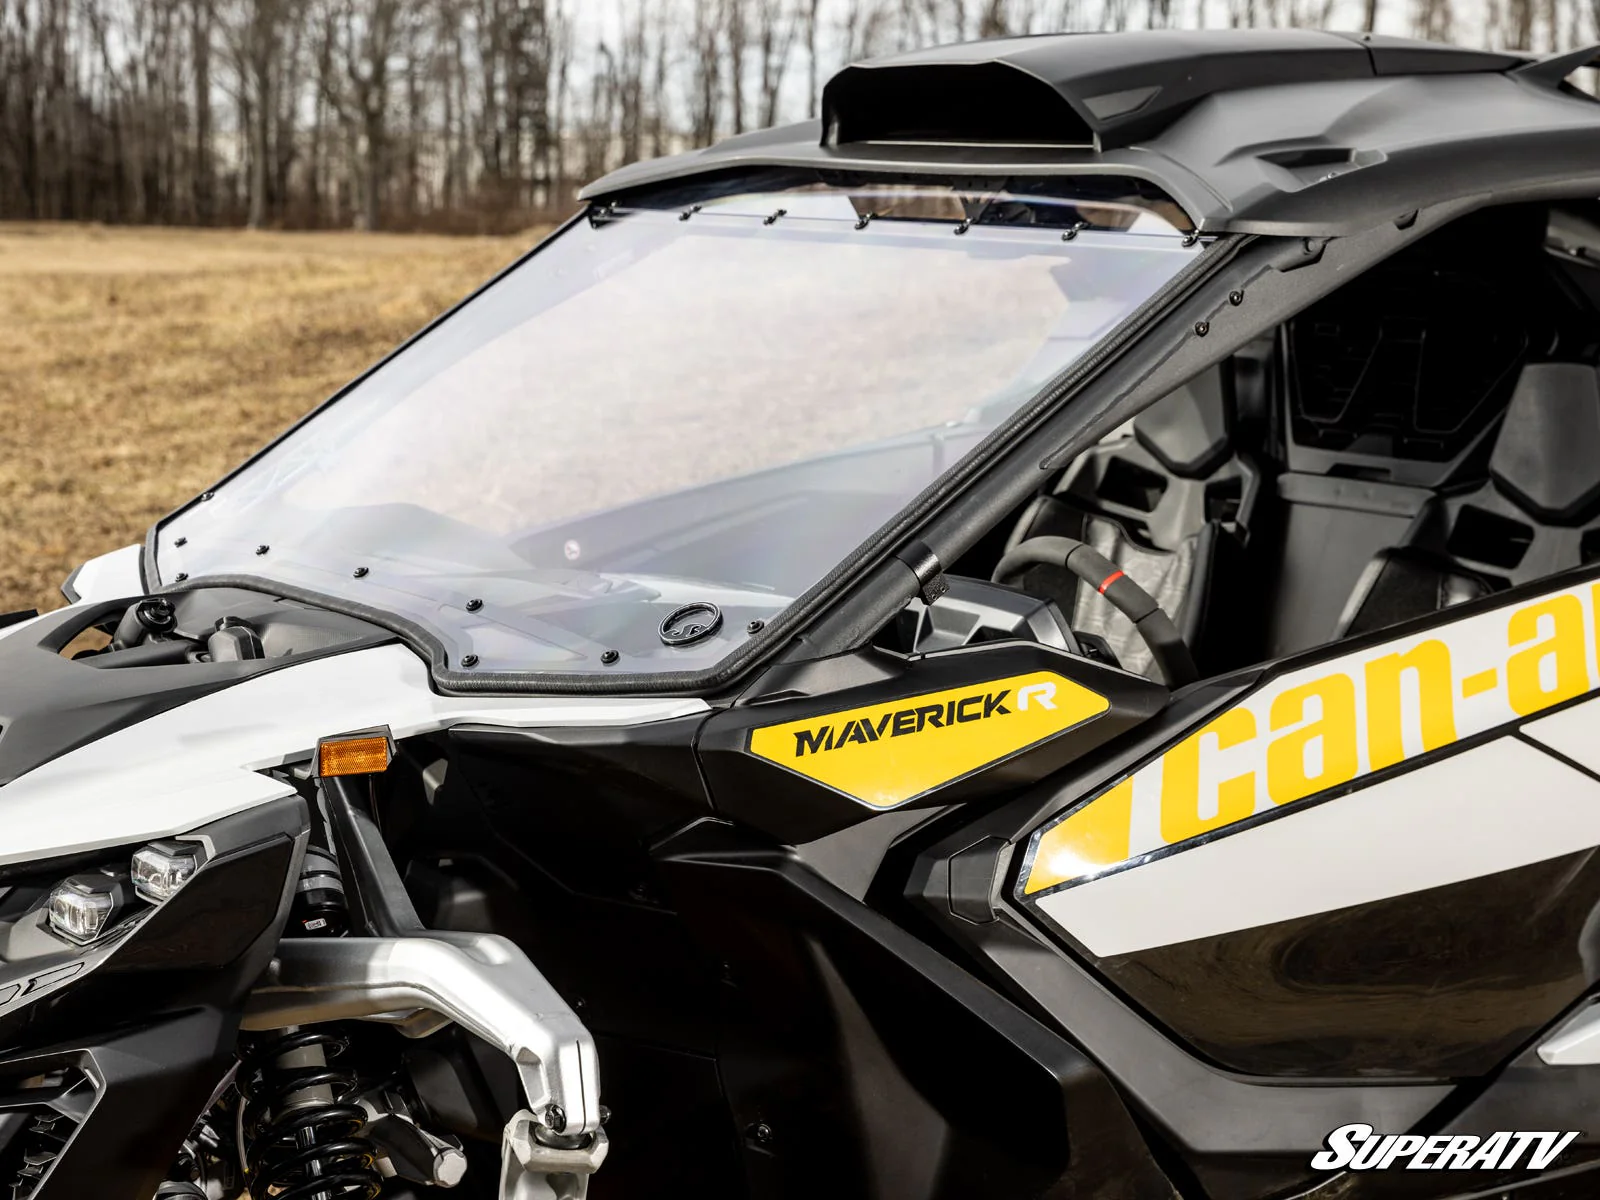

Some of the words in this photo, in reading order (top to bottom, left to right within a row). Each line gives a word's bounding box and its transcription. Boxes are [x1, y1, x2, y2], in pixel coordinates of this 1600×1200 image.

[793, 690, 1011, 757] MAVERICK
[1017, 682, 1058, 711] R
[1160, 582, 1600, 845] can-a
